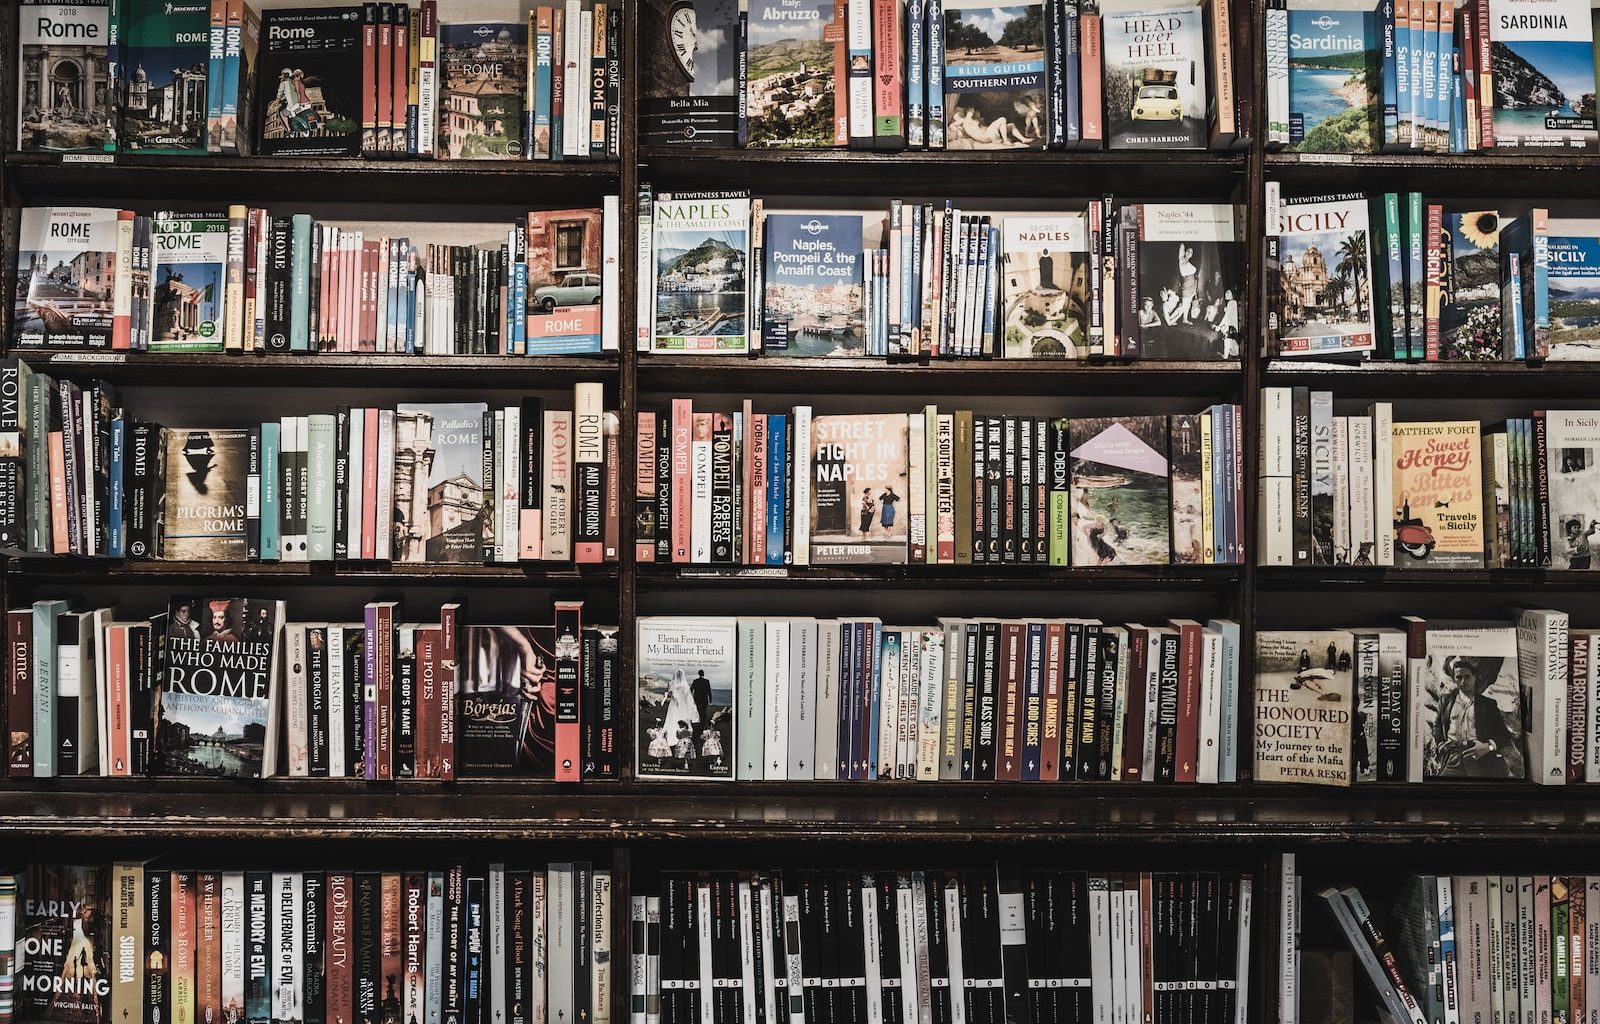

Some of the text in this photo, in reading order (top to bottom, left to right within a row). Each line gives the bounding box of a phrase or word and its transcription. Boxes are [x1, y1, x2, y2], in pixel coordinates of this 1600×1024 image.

[59, 8, 76, 16] 2018
[763, 7, 820, 20] Abruzzo
[1501, 16, 1568, 29] SARDINIA
[38, 18, 98, 38] Rome
[176, 33, 207, 42] ROME
[269, 26, 314, 39] Rome
[1124, 19, 1181, 33] HEAD
[1134, 33, 1172, 42] over
[211, 28, 223, 59] ROME
[226, 27, 240, 57] ROME
[537, 36, 550, 66] ROME
[911, 23, 920, 83] Southern Italy
[1128, 42, 1180, 58] HEEL
[1268, 14, 1277, 78] SARDINIA
[1278, 15, 1288, 79] SARDINIA
[1290, 33, 1363, 51] Sardinia
[1385, 25, 1393, 57] Sardinia
[1481, 38, 1489, 71] SARDINIA
[463, 64, 503, 75] ROME
[609, 60, 618, 87] ROME
[953, 76, 1037, 88] SOUTHERN ITALY
[958, 64, 1032, 75] BLUE GUIDE
[1398, 47, 1408, 92] Sardinia
[1411, 49, 1421, 96] Sardinia
[1425, 51, 1435, 98] Sardinia
[594, 68, 604, 110] ROME
[658, 205, 730, 219] NAPLES
[1280, 212, 1350, 232] SICILY
[51, 223, 90, 237] ROME
[207, 224, 225, 232] 2018
[1019, 232, 1069, 241] NAPLES
[157, 236, 201, 249] ROME
[229, 227, 242, 262] ROME
[276, 232, 285, 269] ROME
[793, 239, 836, 251] Naples,
[1390, 233, 1398, 262] SICILY
[1412, 233, 1420, 261] SICILY
[774, 252, 855, 263] Pompeii & the
[776, 264, 852, 276] Amalfi Coast
[1427, 248, 1440, 286] SICILY
[1548, 252, 1586, 262] SICILY
[389, 262, 398, 288] ROME
[545, 320, 582, 331] ROME
[3, 368, 17, 427] ROME
[441, 419, 478, 429] Palladio's
[579, 415, 598, 458] ROME
[754, 419, 762, 453] TOBIAS
[1565, 418, 1598, 428] In Sicily
[438, 434, 478, 444] ROME
[552, 420, 567, 480] ROME
[675, 428, 687, 473] POMPEII
[1428, 438, 1469, 453] Sweet
[714, 434, 730, 489] POMPEII
[939, 420, 951, 513] THE SOUTH WINTER
[1314, 426, 1329, 486] SICILY
[337, 459, 345, 484] Rome
[817, 463, 887, 481] NAPLES
[1055, 452, 1065, 489] DIBDIN
[586, 467, 599, 535] AND ENVIRONS
[659, 447, 669, 529] FROM POMPEII
[177, 506, 244, 519] PILGRIM'S
[204, 521, 244, 531] ROME
[713, 496, 721, 542] HARRIS
[722, 496, 730, 542] ROBERT
[1437, 513, 1476, 522] Travels
[817, 545, 871, 556] PETER ROBB
[171, 638, 269, 655] THE FAMILIES
[648, 645, 724, 656] My Brilliant Friend
[658, 634, 712, 644] Elena Ferrante
[1549, 620, 1557, 680] SHADOWS
[1559, 619, 1567, 679] SICILIAN
[17, 642, 27, 680] rome
[172, 651, 266, 670] WHO MADE
[331, 632, 340, 713] POPE FRANCIS
[40, 660, 48, 713] BERNINI
[169, 668, 267, 698] ROME
[313, 671, 321, 710] BORGIAS
[424, 661, 433, 699] POPES
[1161, 640, 1177, 724] GERALD SEYMOUR
[402, 665, 410, 735] IN GOD'S NAME
[463, 699, 516, 717] Borgias
[1258, 689, 1288, 702] THE
[1381, 677, 1390, 720] BATTLE
[1045, 699, 1057, 738] DARKNESS
[1257, 707, 1348, 723] HONOURED
[1256, 724, 1322, 739] SOCIETY
[1280, 767, 1346, 780] PETRA RESKI
[27, 899, 80, 917] EARLY
[251, 894, 265, 943] MEMORY
[307, 880, 320, 954] the extremist
[594, 878, 604, 943] Imperfectionists
[408, 889, 419, 972] Robert Harris
[25, 938, 62, 956] ONE
[120, 936, 134, 983] SUBURRA
[23, 976, 110, 996] MORNING
